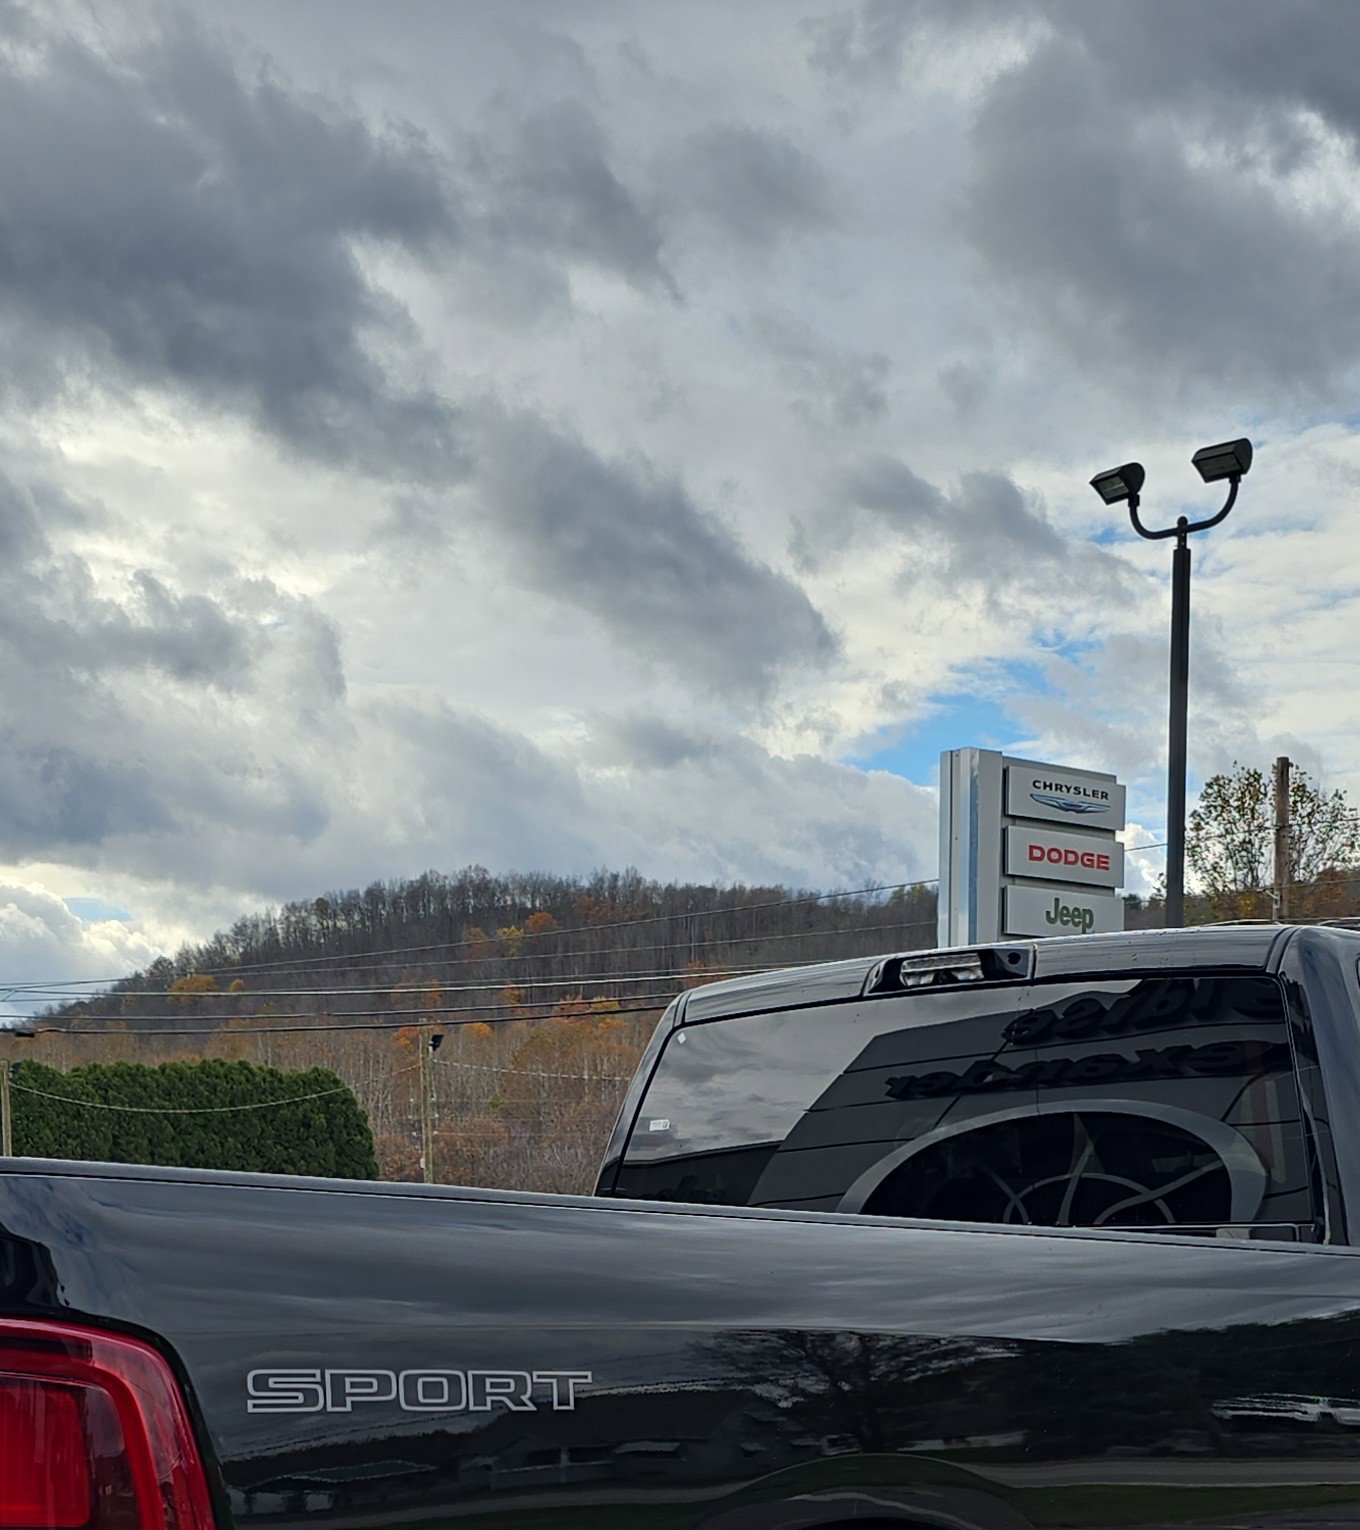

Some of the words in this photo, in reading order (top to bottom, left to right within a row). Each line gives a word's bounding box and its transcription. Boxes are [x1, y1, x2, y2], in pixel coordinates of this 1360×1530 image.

[1032, 779, 1110, 801] CHRYSLER
[1028, 844, 1110, 871] DODGE
[1045, 897, 1094, 934] Jeep
[246, 1368, 593, 1414] SPORT
